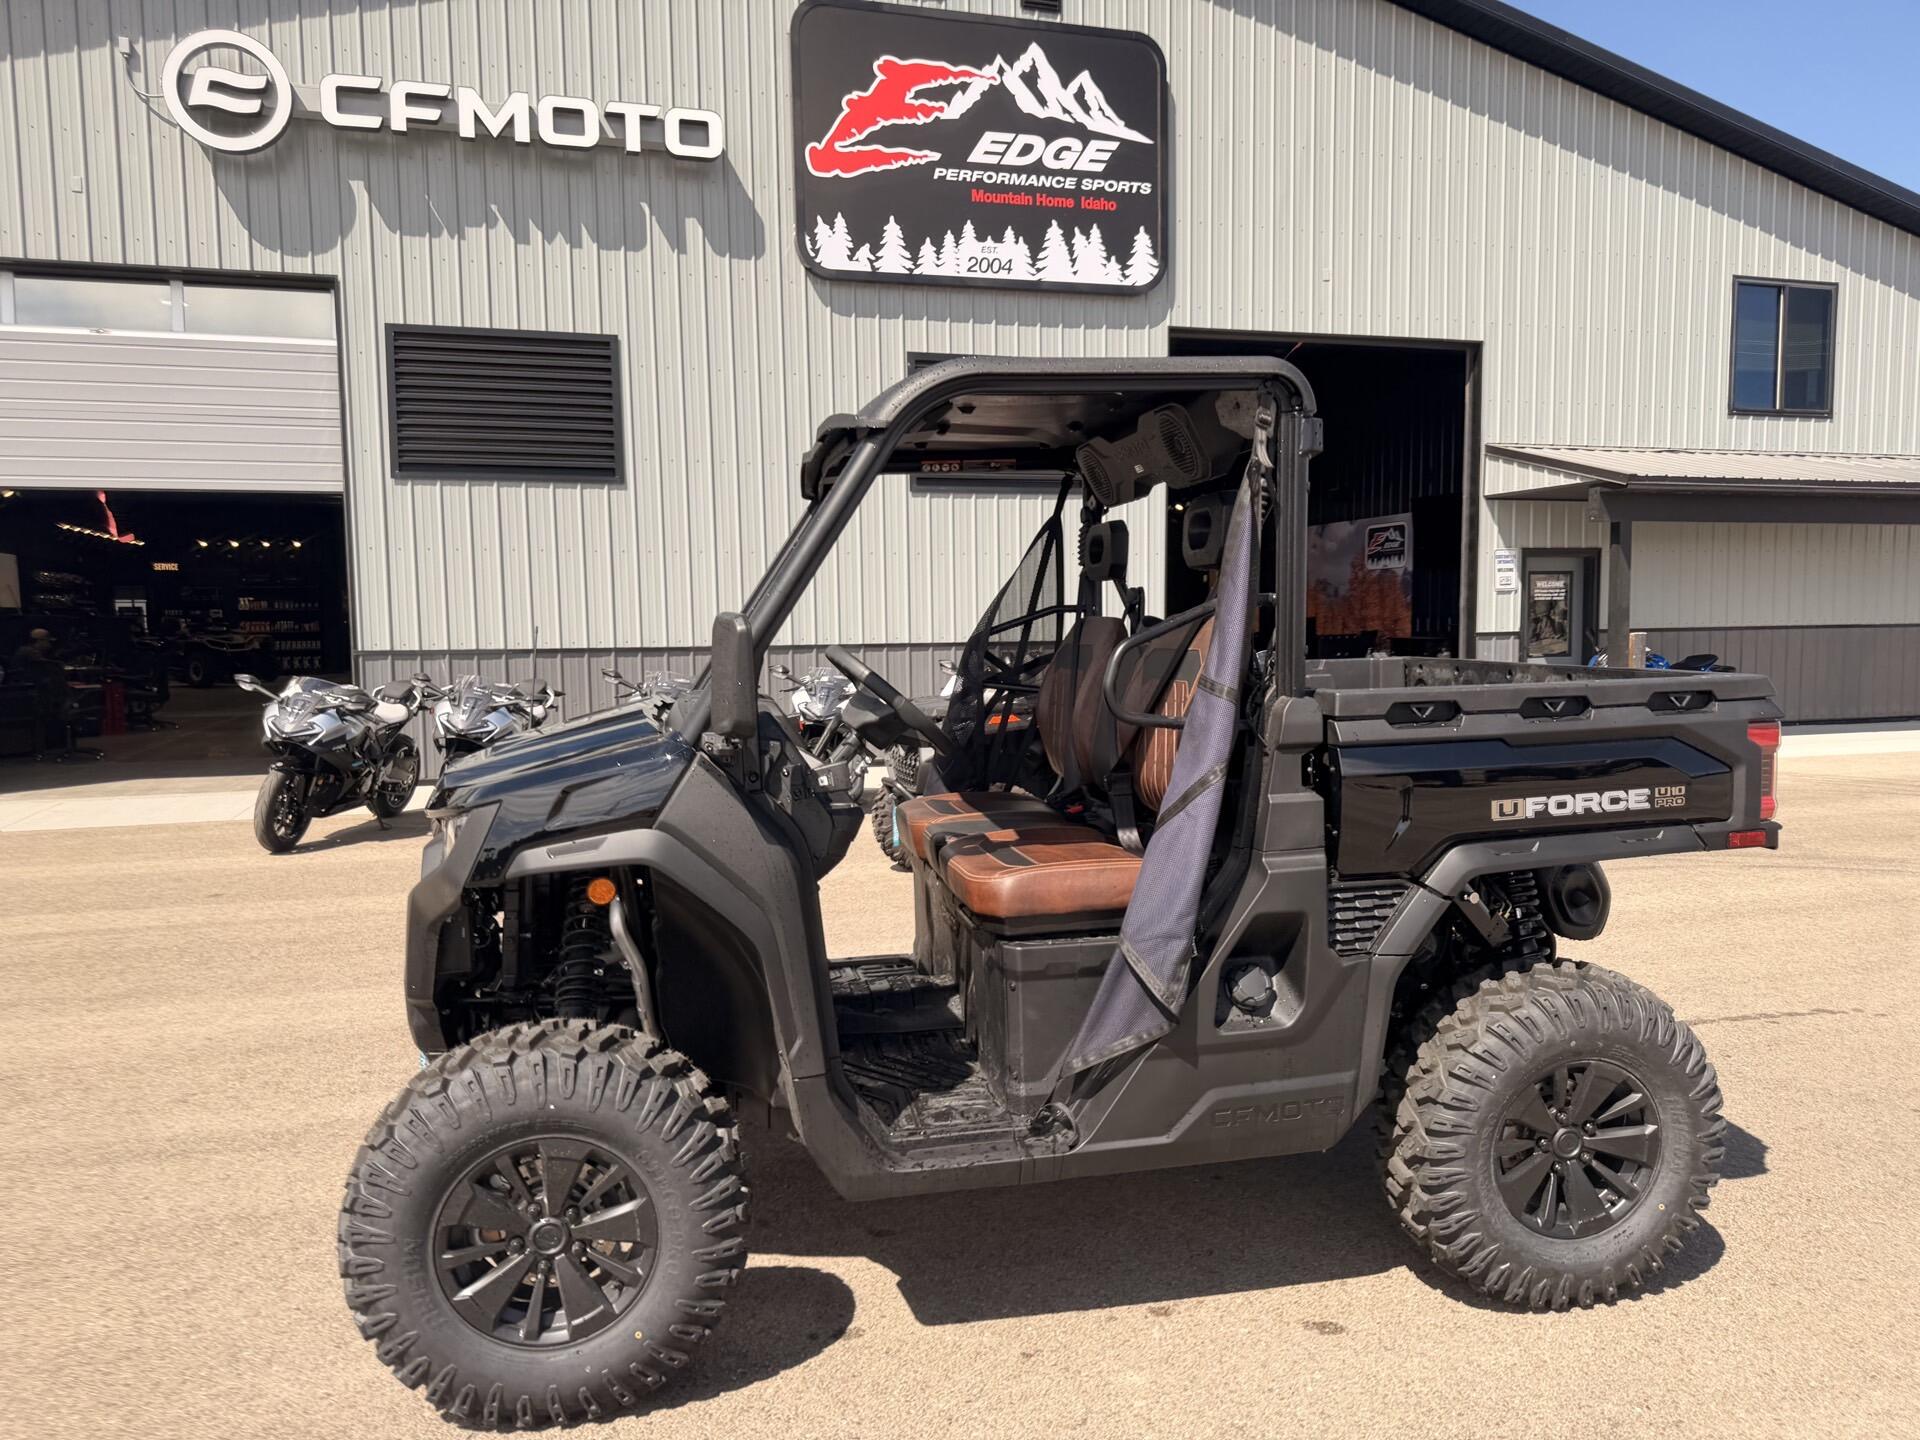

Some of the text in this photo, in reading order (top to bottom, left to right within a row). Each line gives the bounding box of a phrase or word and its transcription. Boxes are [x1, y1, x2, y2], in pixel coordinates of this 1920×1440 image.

[320, 73, 723, 159] CFMOTO
[966, 131, 1120, 172] EDGE
[933, 168, 1152, 195] PERFORMANCE SPORTS
[971, 189, 1117, 211] Mountain Home Idaho
[981, 246, 998, 254] EST.
[967, 256, 1013, 274] 2004
[153, 562, 179, 571] SERVICE
[1655, 786, 1686, 798] U10
[1655, 796, 1686, 808] PRO
